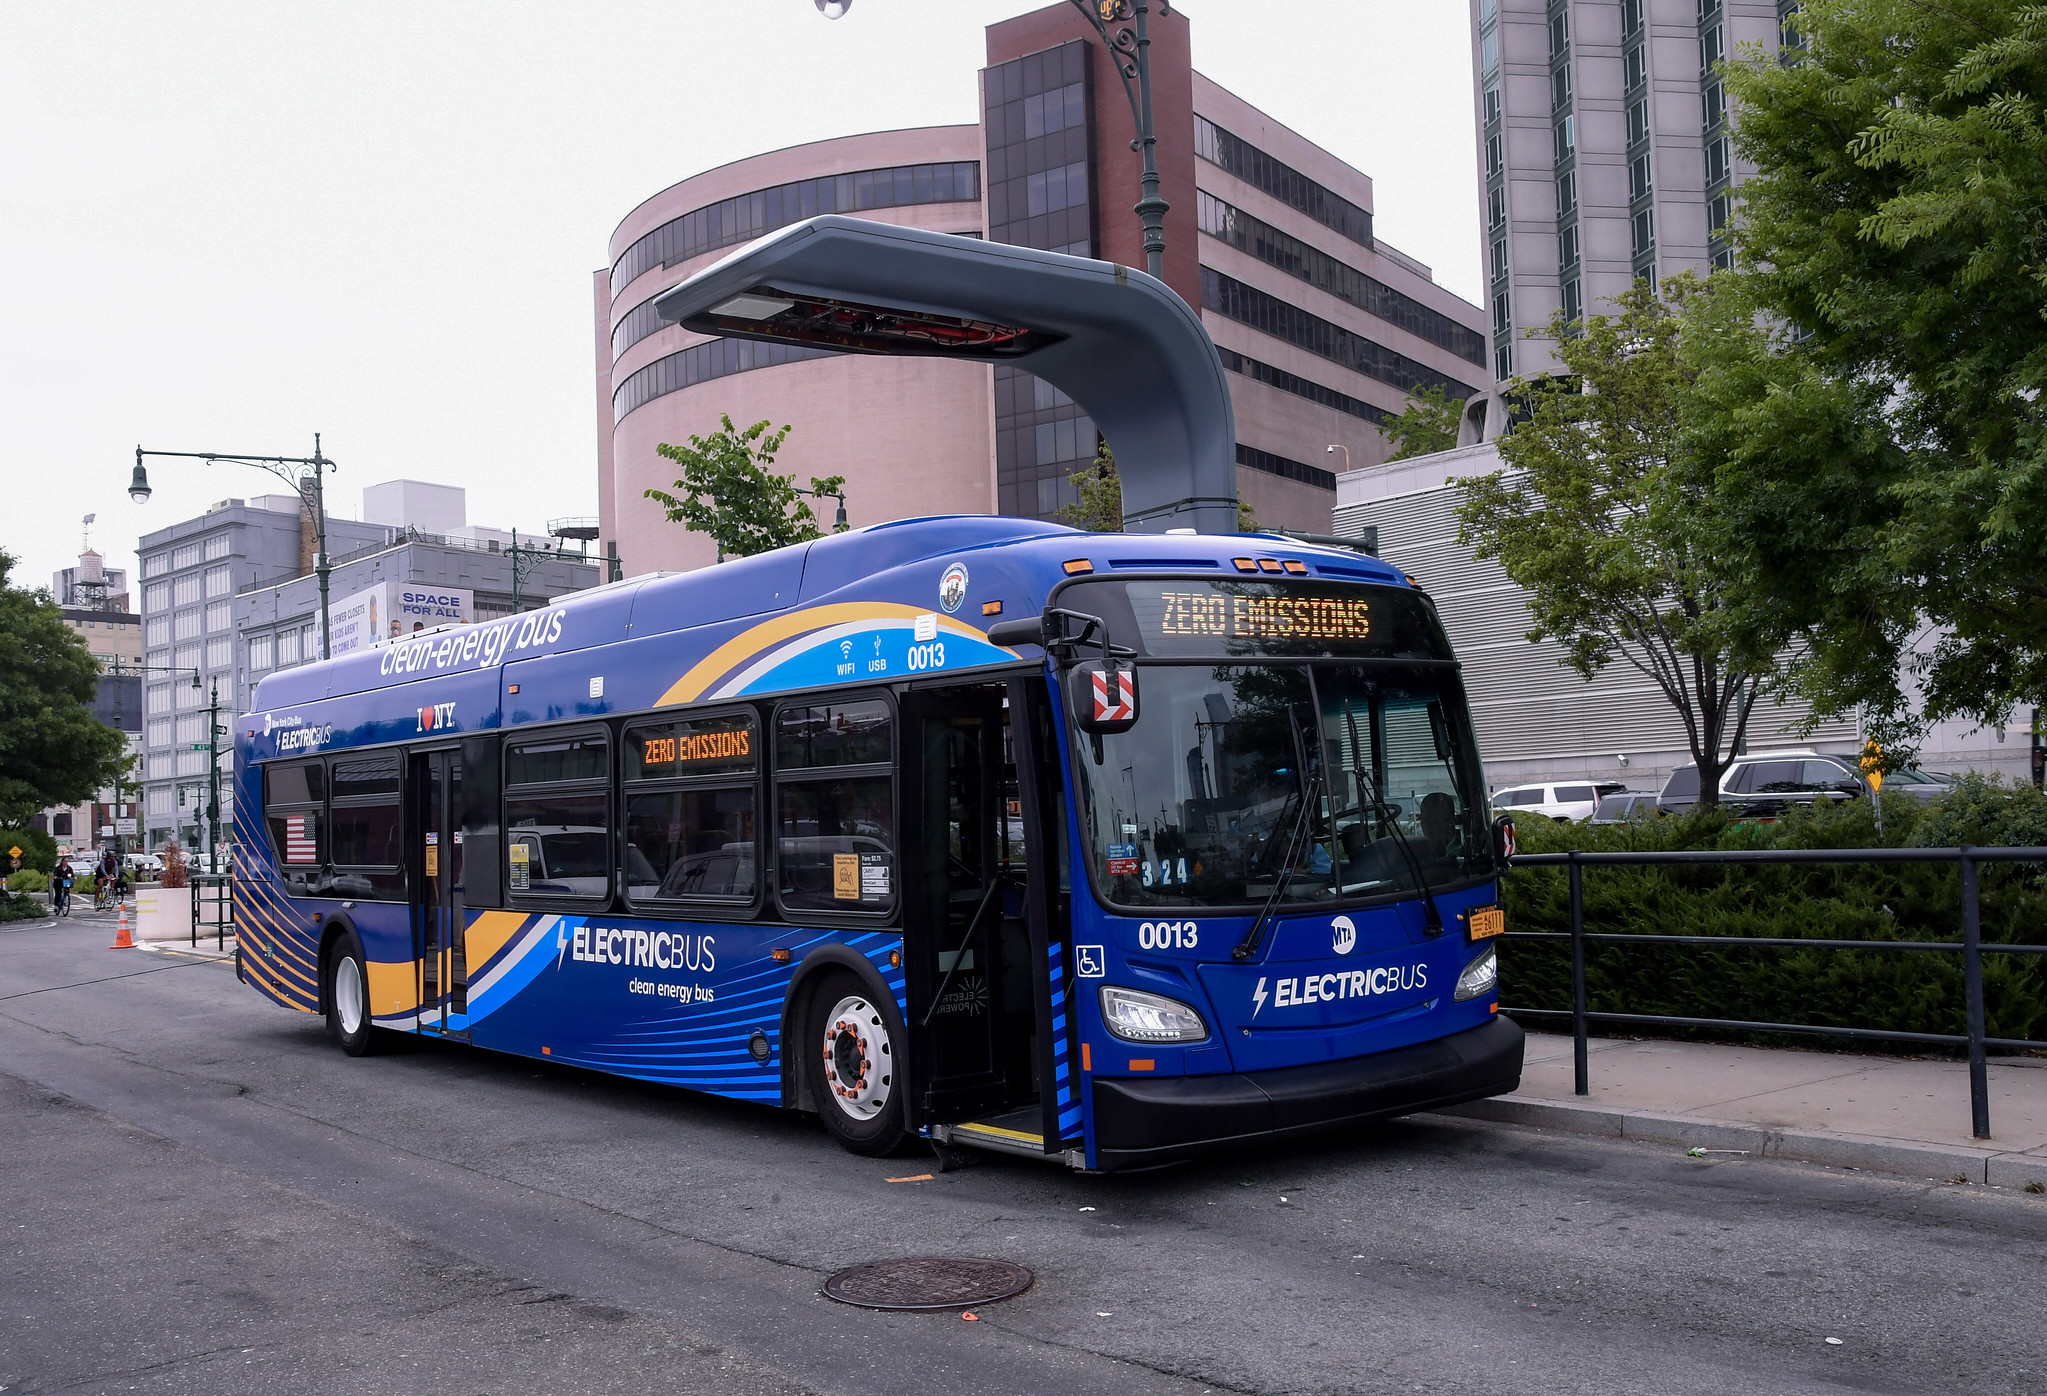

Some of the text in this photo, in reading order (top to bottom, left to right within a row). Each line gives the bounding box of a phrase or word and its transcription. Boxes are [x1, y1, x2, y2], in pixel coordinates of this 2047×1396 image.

[403, 592, 460, 607] SPACE
[403, 605, 461, 618] FOR ALL
[333, 611, 347, 624] FEWER
[348, 604, 364, 619] CLOSETS
[1161, 592, 1369, 639] ZERO EMISSIONS
[334, 627, 344, 639] KIDS
[345, 622, 358, 634] AREN'T
[380, 609, 567, 676] clean-energy bus
[332, 644, 338, 656] TO
[337, 640, 350, 653] COME
[350, 636, 359, 648] OUT
[907, 642, 945, 671] 0013
[836, 659, 887, 676] WIFI USB
[416, 701, 456, 732] I NY
[644, 730, 750, 765] ZERO EMISSIONS
[1138, 921, 1198, 950] 0013
[629, 976, 714, 1004] clean energy bus
